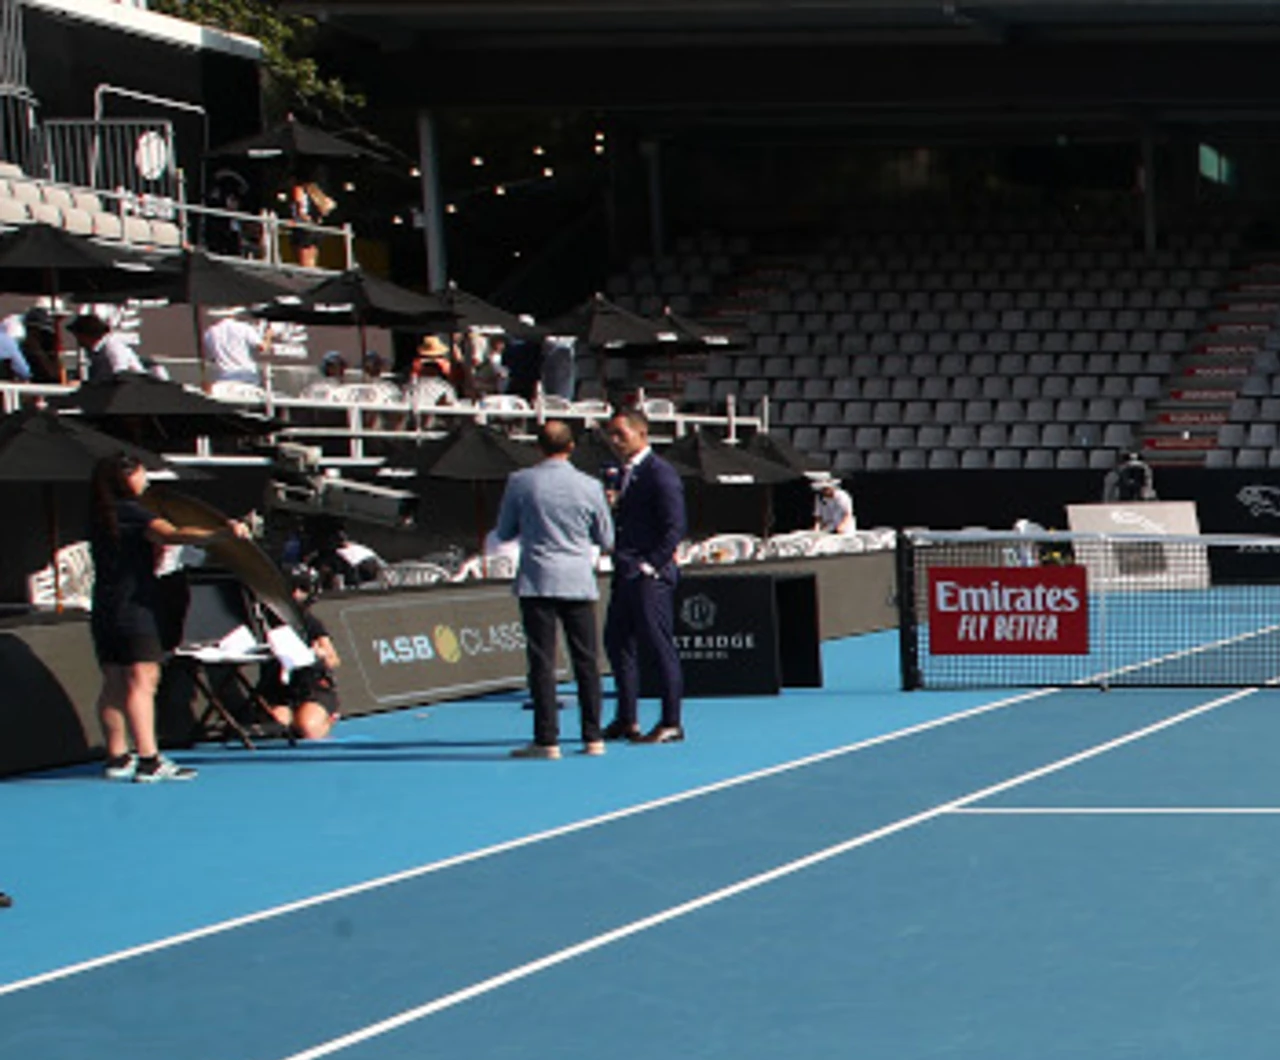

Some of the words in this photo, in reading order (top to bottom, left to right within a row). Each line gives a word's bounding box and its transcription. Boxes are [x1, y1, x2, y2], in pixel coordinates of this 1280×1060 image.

[935, 580, 1080, 612] Emirates
[957, 614, 990, 641] FLY
[993, 614, 1059, 641] BETTER
